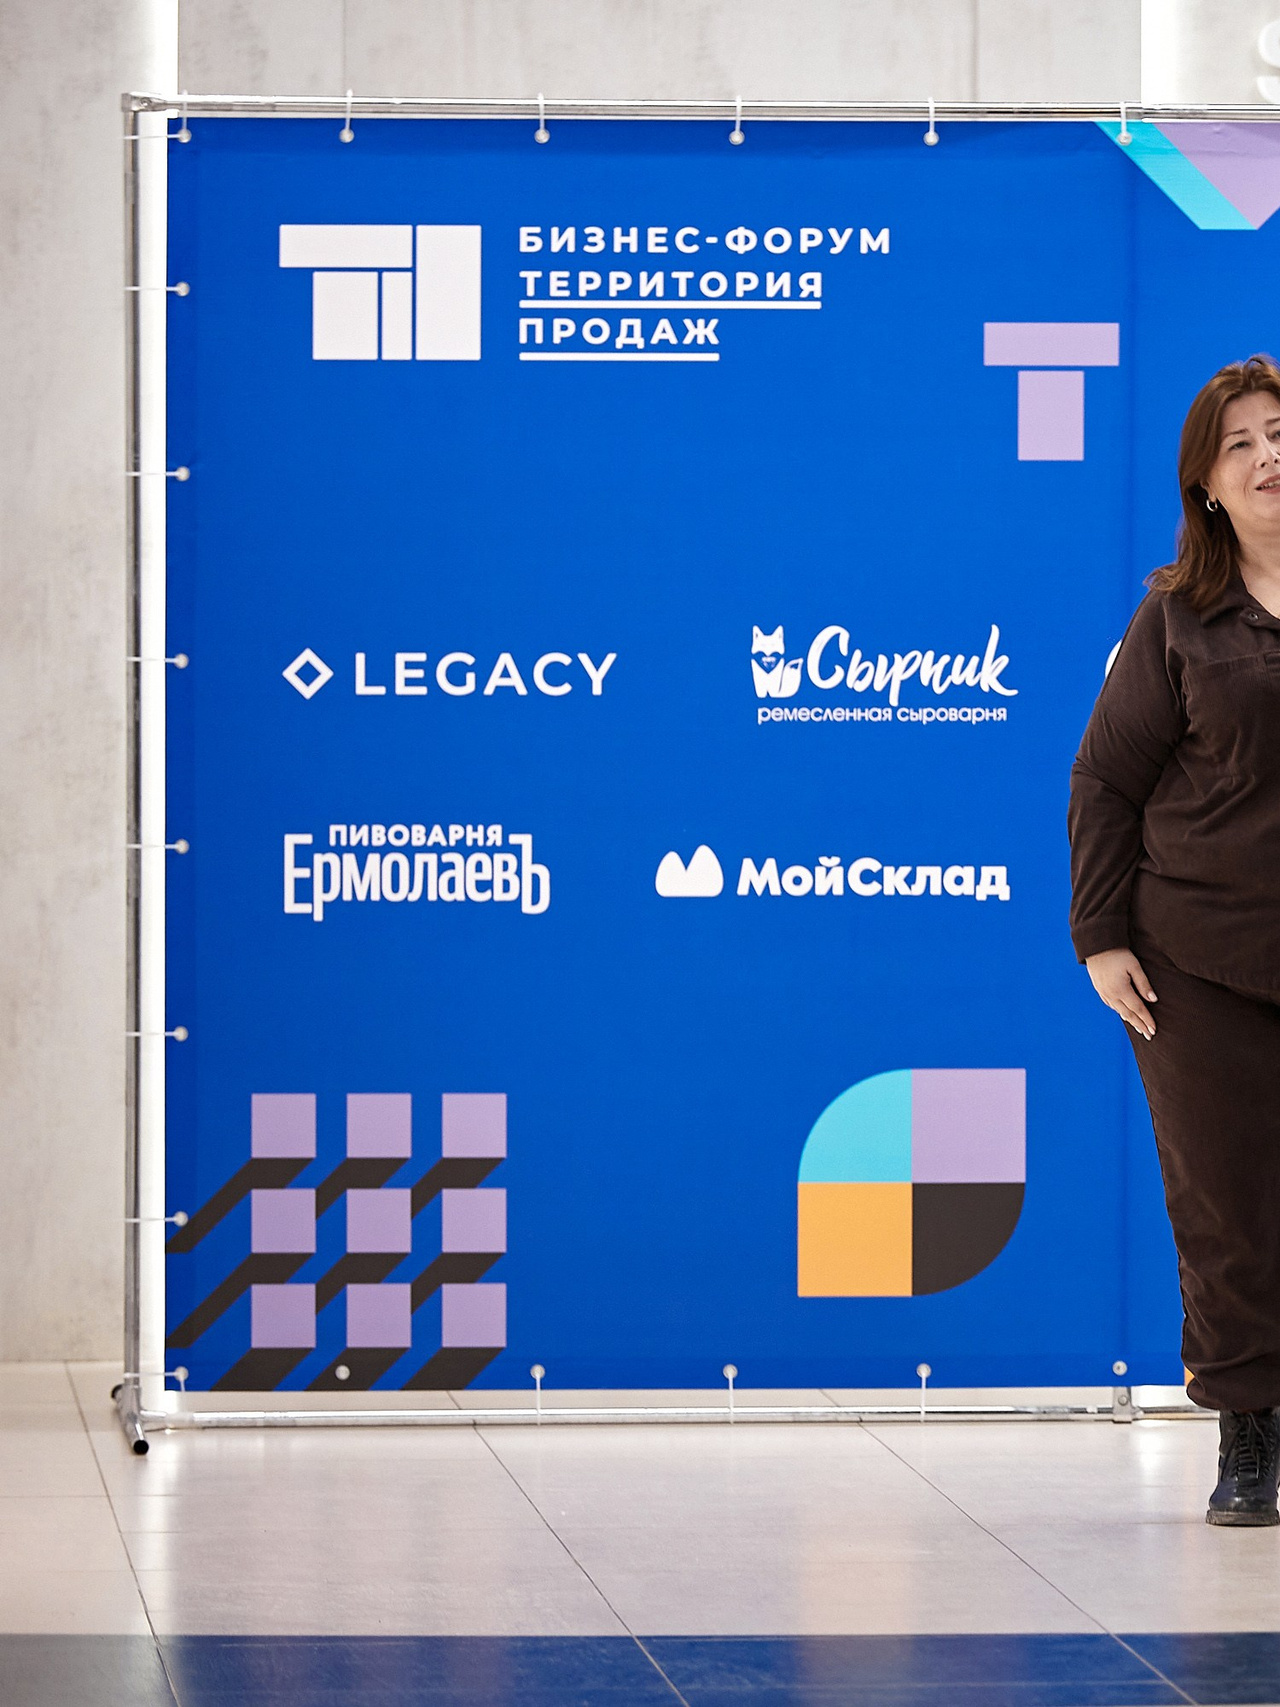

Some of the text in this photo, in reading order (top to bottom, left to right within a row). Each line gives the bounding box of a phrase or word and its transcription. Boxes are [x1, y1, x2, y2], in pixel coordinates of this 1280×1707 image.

[519, 226, 891, 255] БИЗНЕС-ФОРУМ
[519, 271, 823, 298] ТЕРРИТОРИЯ
[519, 317, 720, 349] ПРОДАЖ
[355, 652, 618, 696] LEGACY
[757, 706, 1008, 726] ремесленная сыроварня
[328, 824, 503, 847] ПИВОВАРНЯ
[736, 856, 1011, 902] МойСклад
